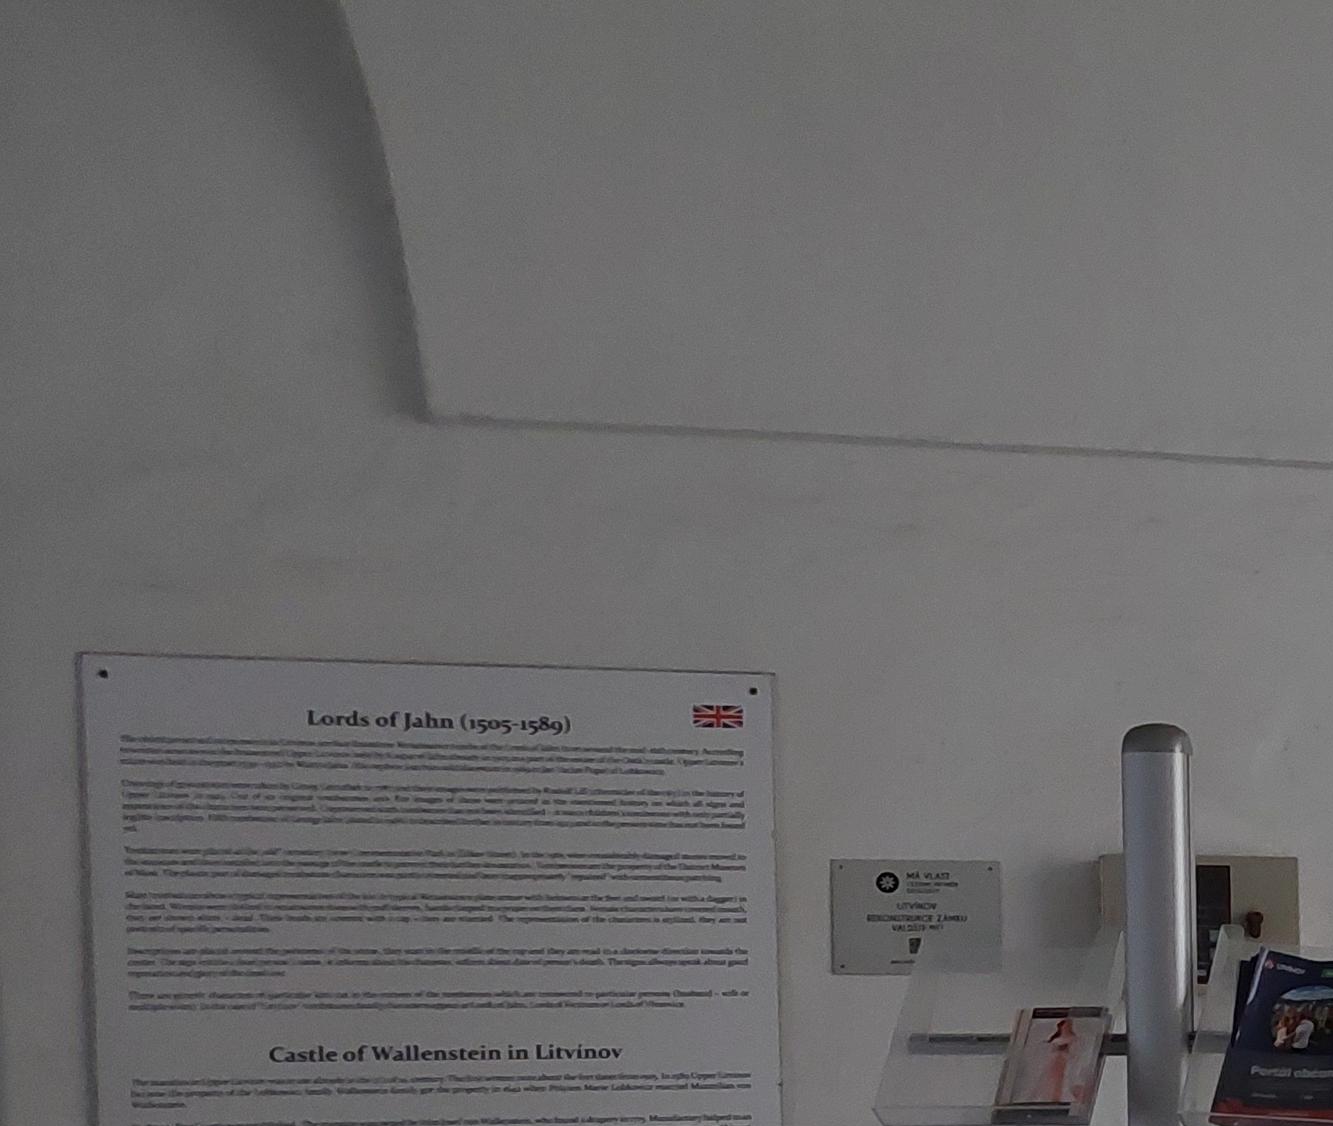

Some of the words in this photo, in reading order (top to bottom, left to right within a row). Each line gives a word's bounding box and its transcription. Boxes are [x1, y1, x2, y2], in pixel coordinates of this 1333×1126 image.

[306, 708, 370, 729] Lords
[375, 709, 399, 730] of
[403, 711, 454, 733] Jahn
[460, 713, 572, 735] (1505-1589)
[268, 1043, 338, 1064] Castle
[342, 1043, 366, 1063] of
[370, 1043, 502, 1063] Wallenstein
[507, 1043, 529, 1062] in
[534, 1042, 623, 1062] Litvínov
